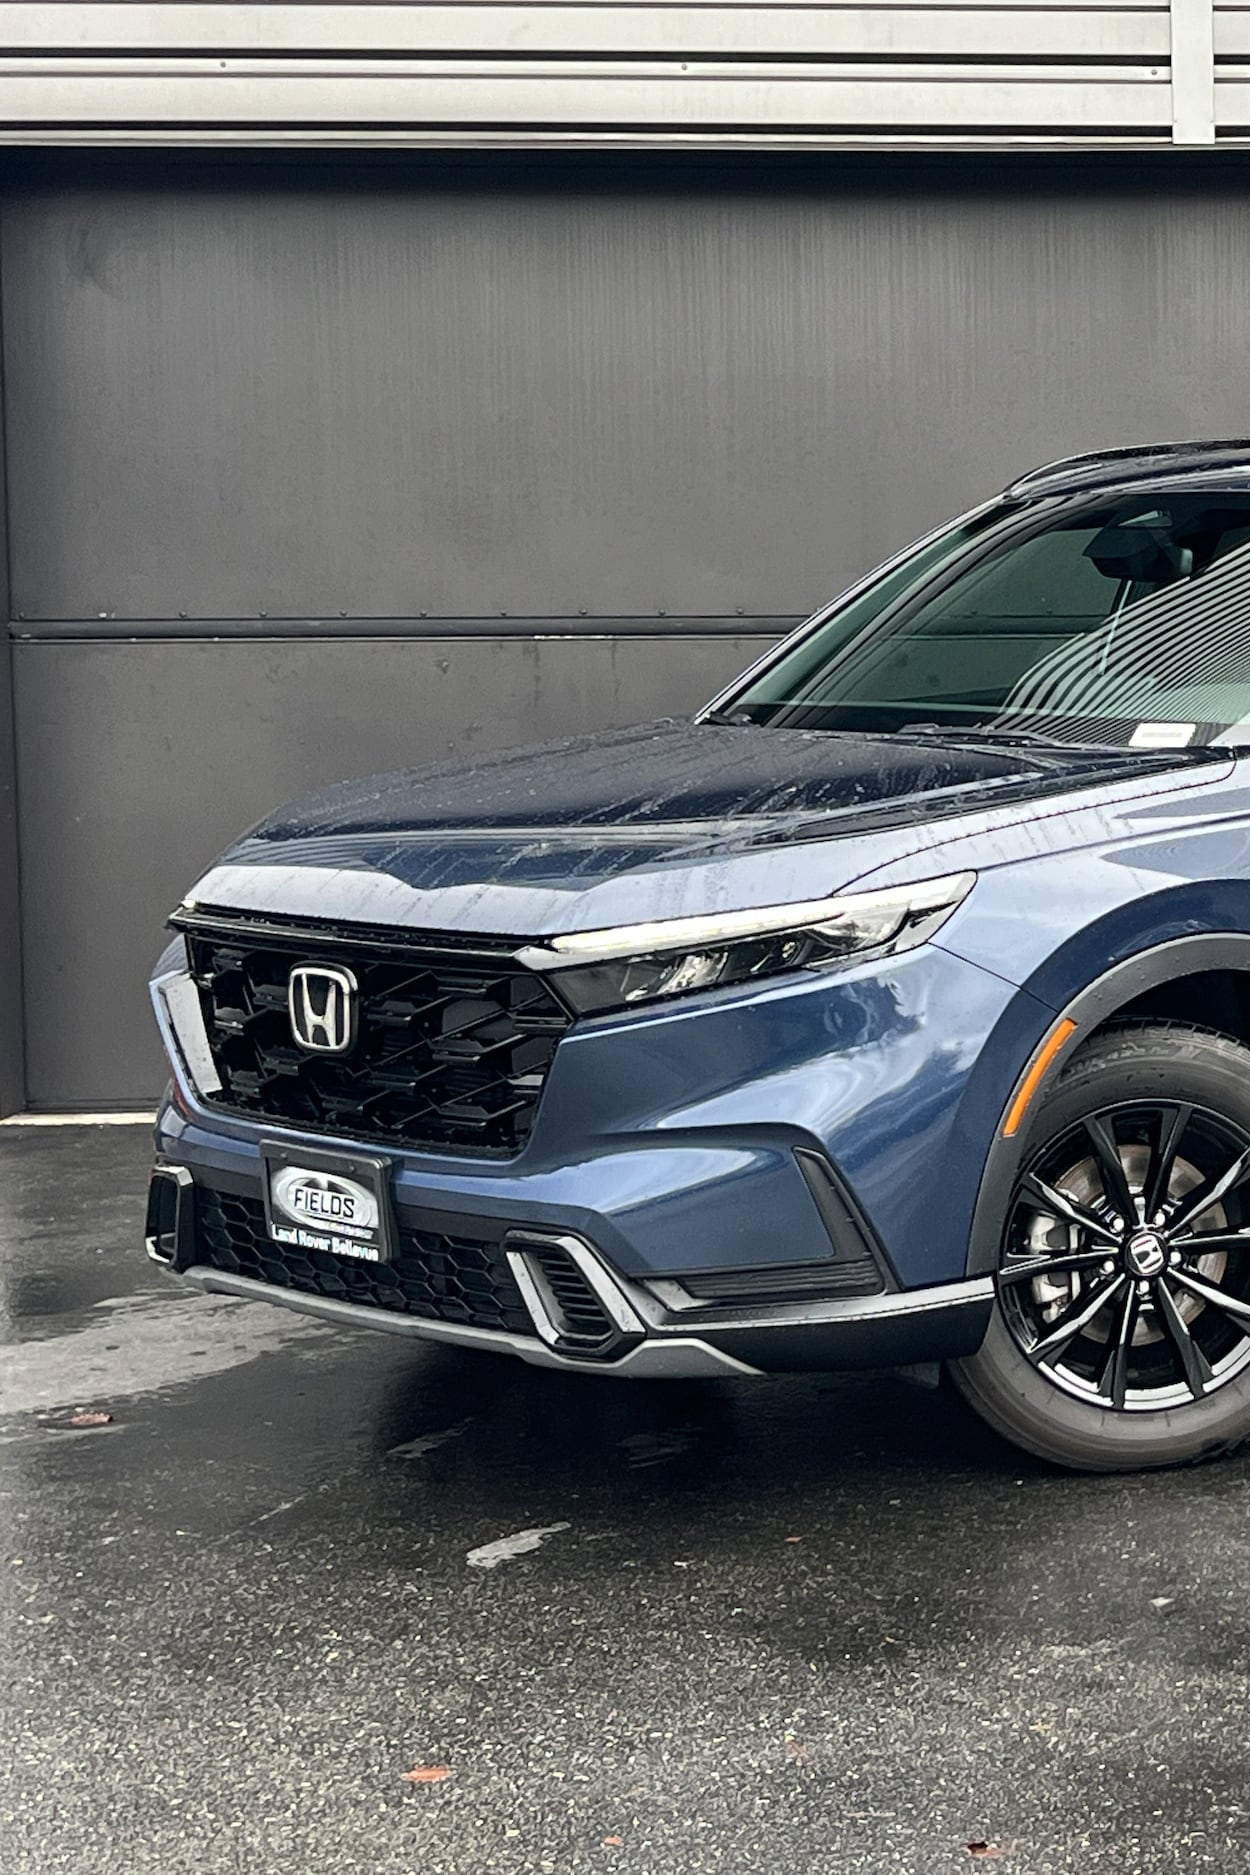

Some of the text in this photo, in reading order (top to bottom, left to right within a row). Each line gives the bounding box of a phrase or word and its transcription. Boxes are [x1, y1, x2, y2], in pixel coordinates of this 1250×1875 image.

[294, 1188, 355, 1219] FIELDS
[271, 1223, 298, 1245] Land
[298, 1229, 331, 1252] Rover
[331, 1237, 379, 1262] Bellevue
